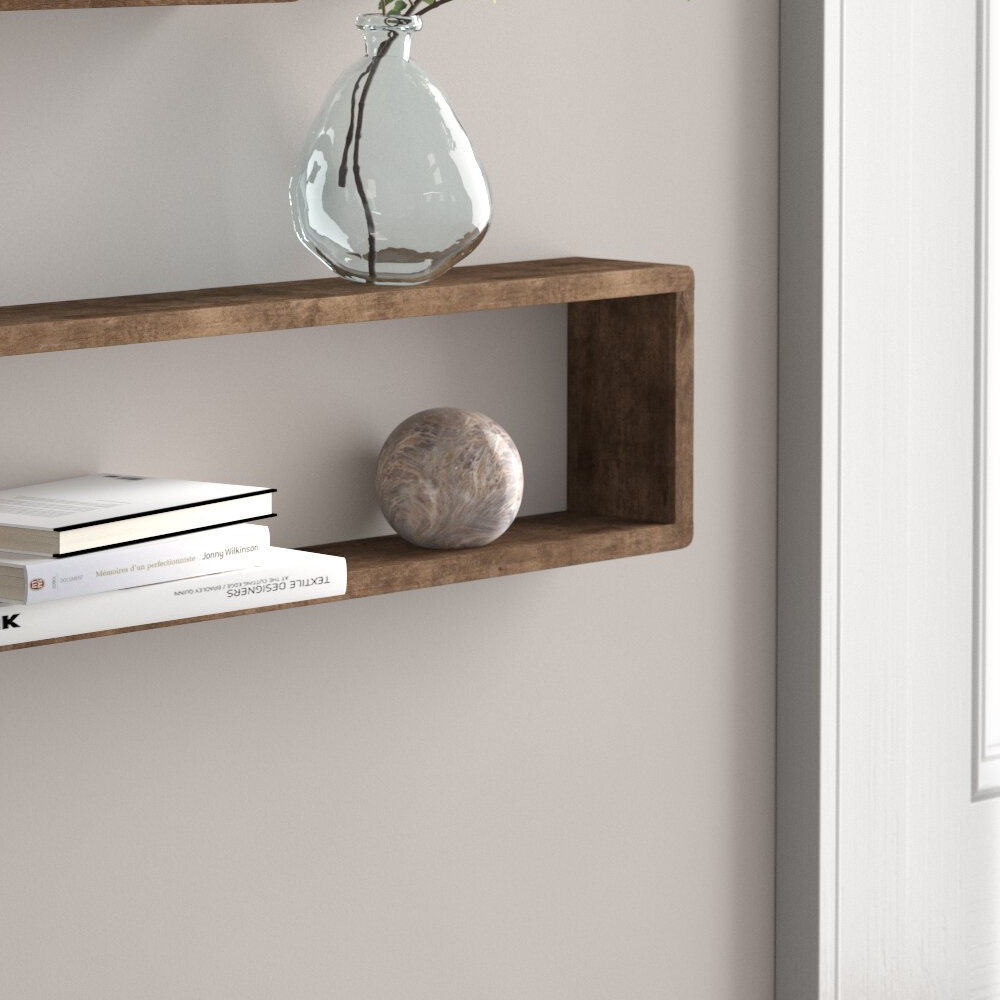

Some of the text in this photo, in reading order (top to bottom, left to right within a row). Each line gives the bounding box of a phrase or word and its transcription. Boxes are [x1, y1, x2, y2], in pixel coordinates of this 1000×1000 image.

[202, 544, 258, 560] Jonny Wilkinson
[95, 567, 128, 578] Mémoires
[147, 556, 196, 570] perfectionniste
[226, 576, 330, 597] TEXTILE DESIGNERS
[2, 614, 20, 629] K
